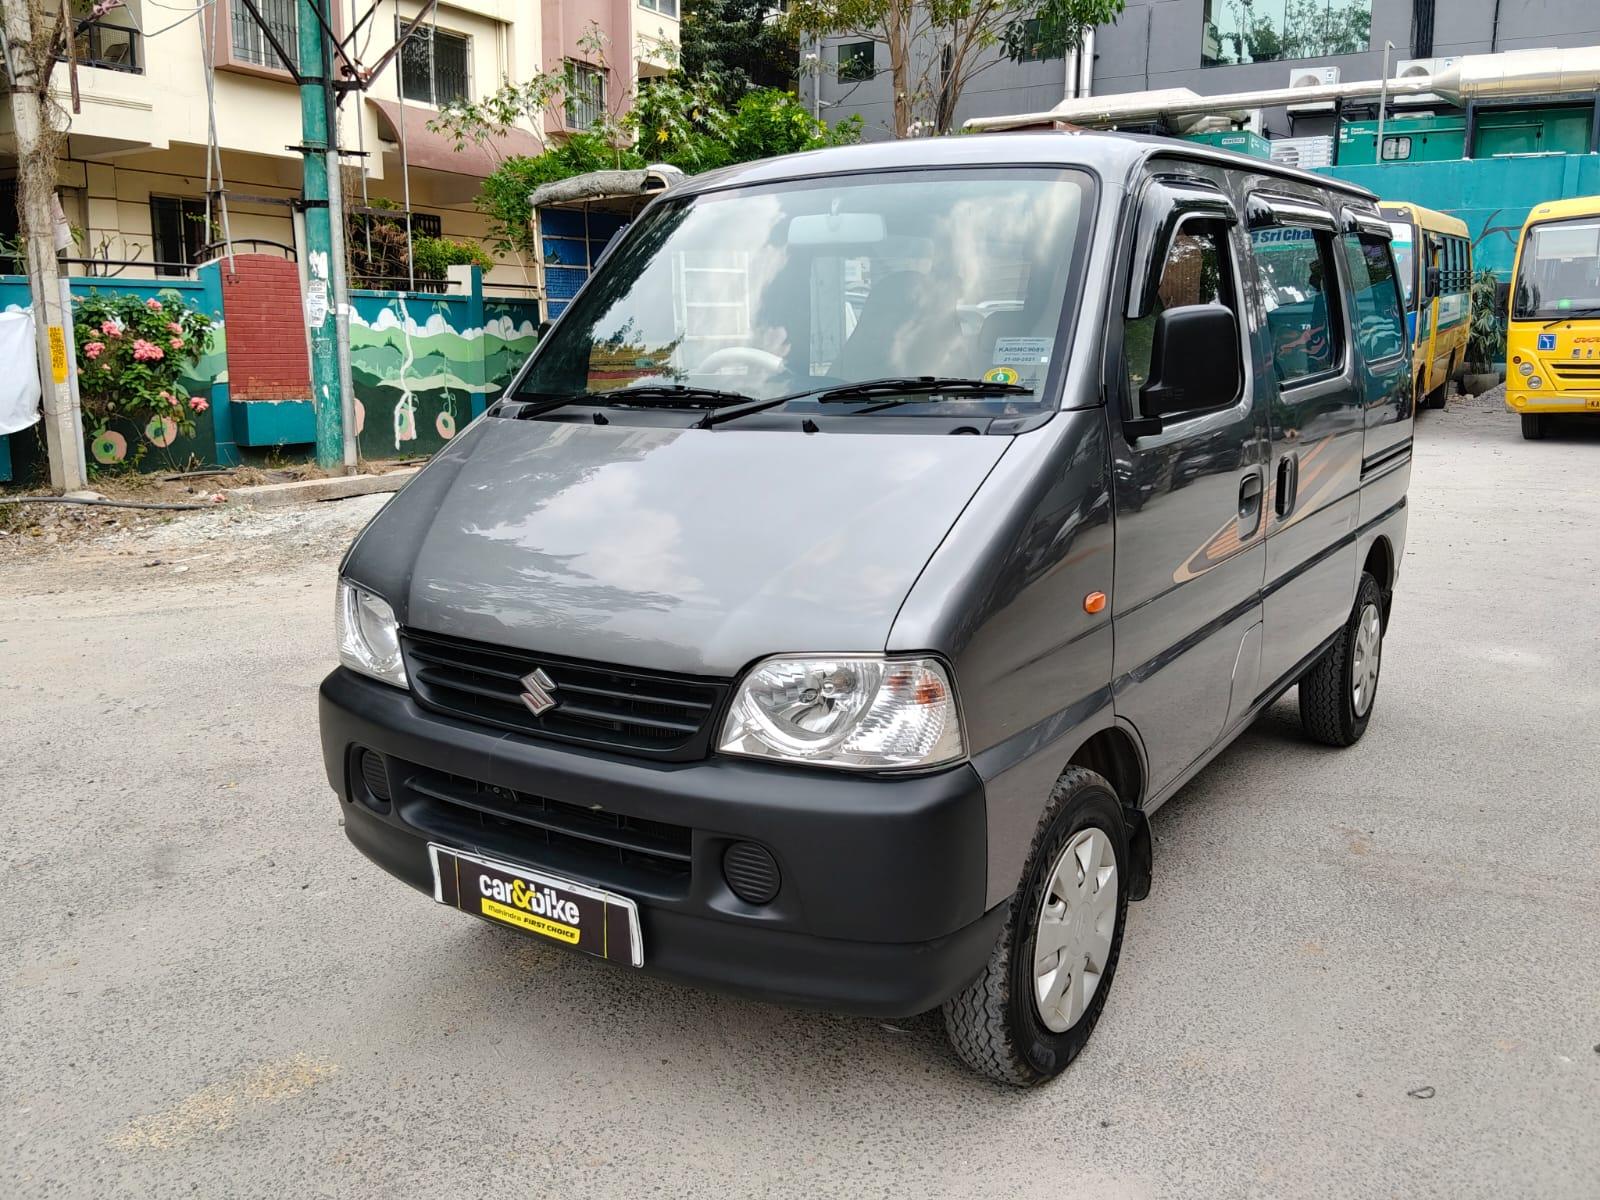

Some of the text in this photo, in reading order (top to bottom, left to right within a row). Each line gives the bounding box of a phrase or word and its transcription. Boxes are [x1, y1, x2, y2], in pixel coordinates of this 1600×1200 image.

[1260, 229, 1282, 243] Sri
[479, 874, 580, 925] car&bike
[488, 904, 576, 939] Mahindra FIRST CHOICE
